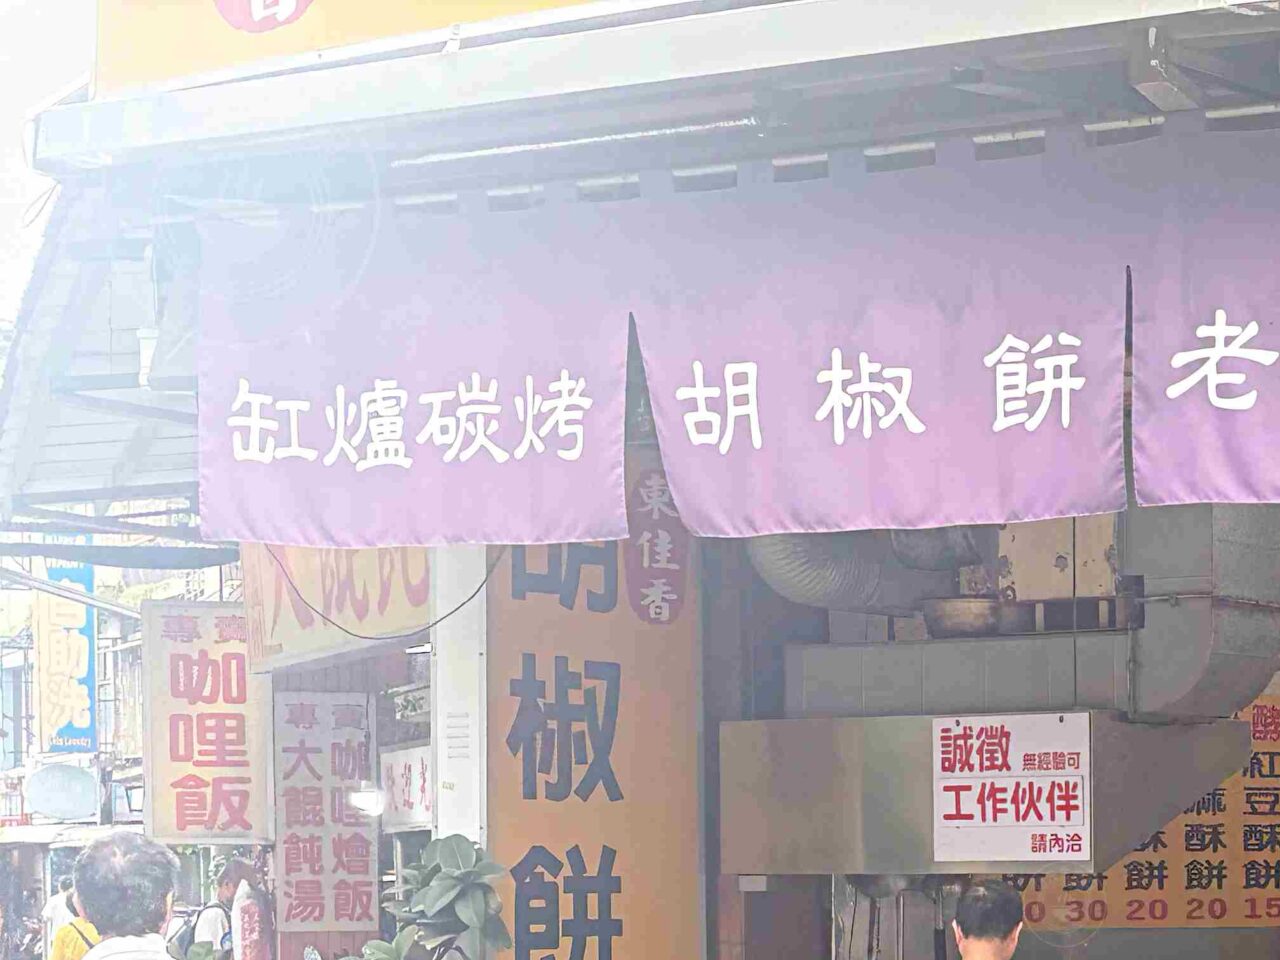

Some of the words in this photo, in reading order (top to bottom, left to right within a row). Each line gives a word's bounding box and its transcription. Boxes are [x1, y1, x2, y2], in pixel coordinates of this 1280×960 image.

[227, 368, 594, 471] 缸爐碳烤
[675, 331, 1085, 455] 胡椒餅
[637, 472, 680, 621] 東佳香
[169, 649, 252, 831] 咖哩飯
[940, 724, 1011, 773] 誠徵
[1022, 752, 1081, 771] 無經驗可
[282, 739, 324, 922] 大餛飩湯
[943, 781, 1080, 823] 工作伙伴
[1065, 899, 1108, 921] 30
[1126, 900, 1168, 920] 20
[1186, 899, 1228, 920] 20
